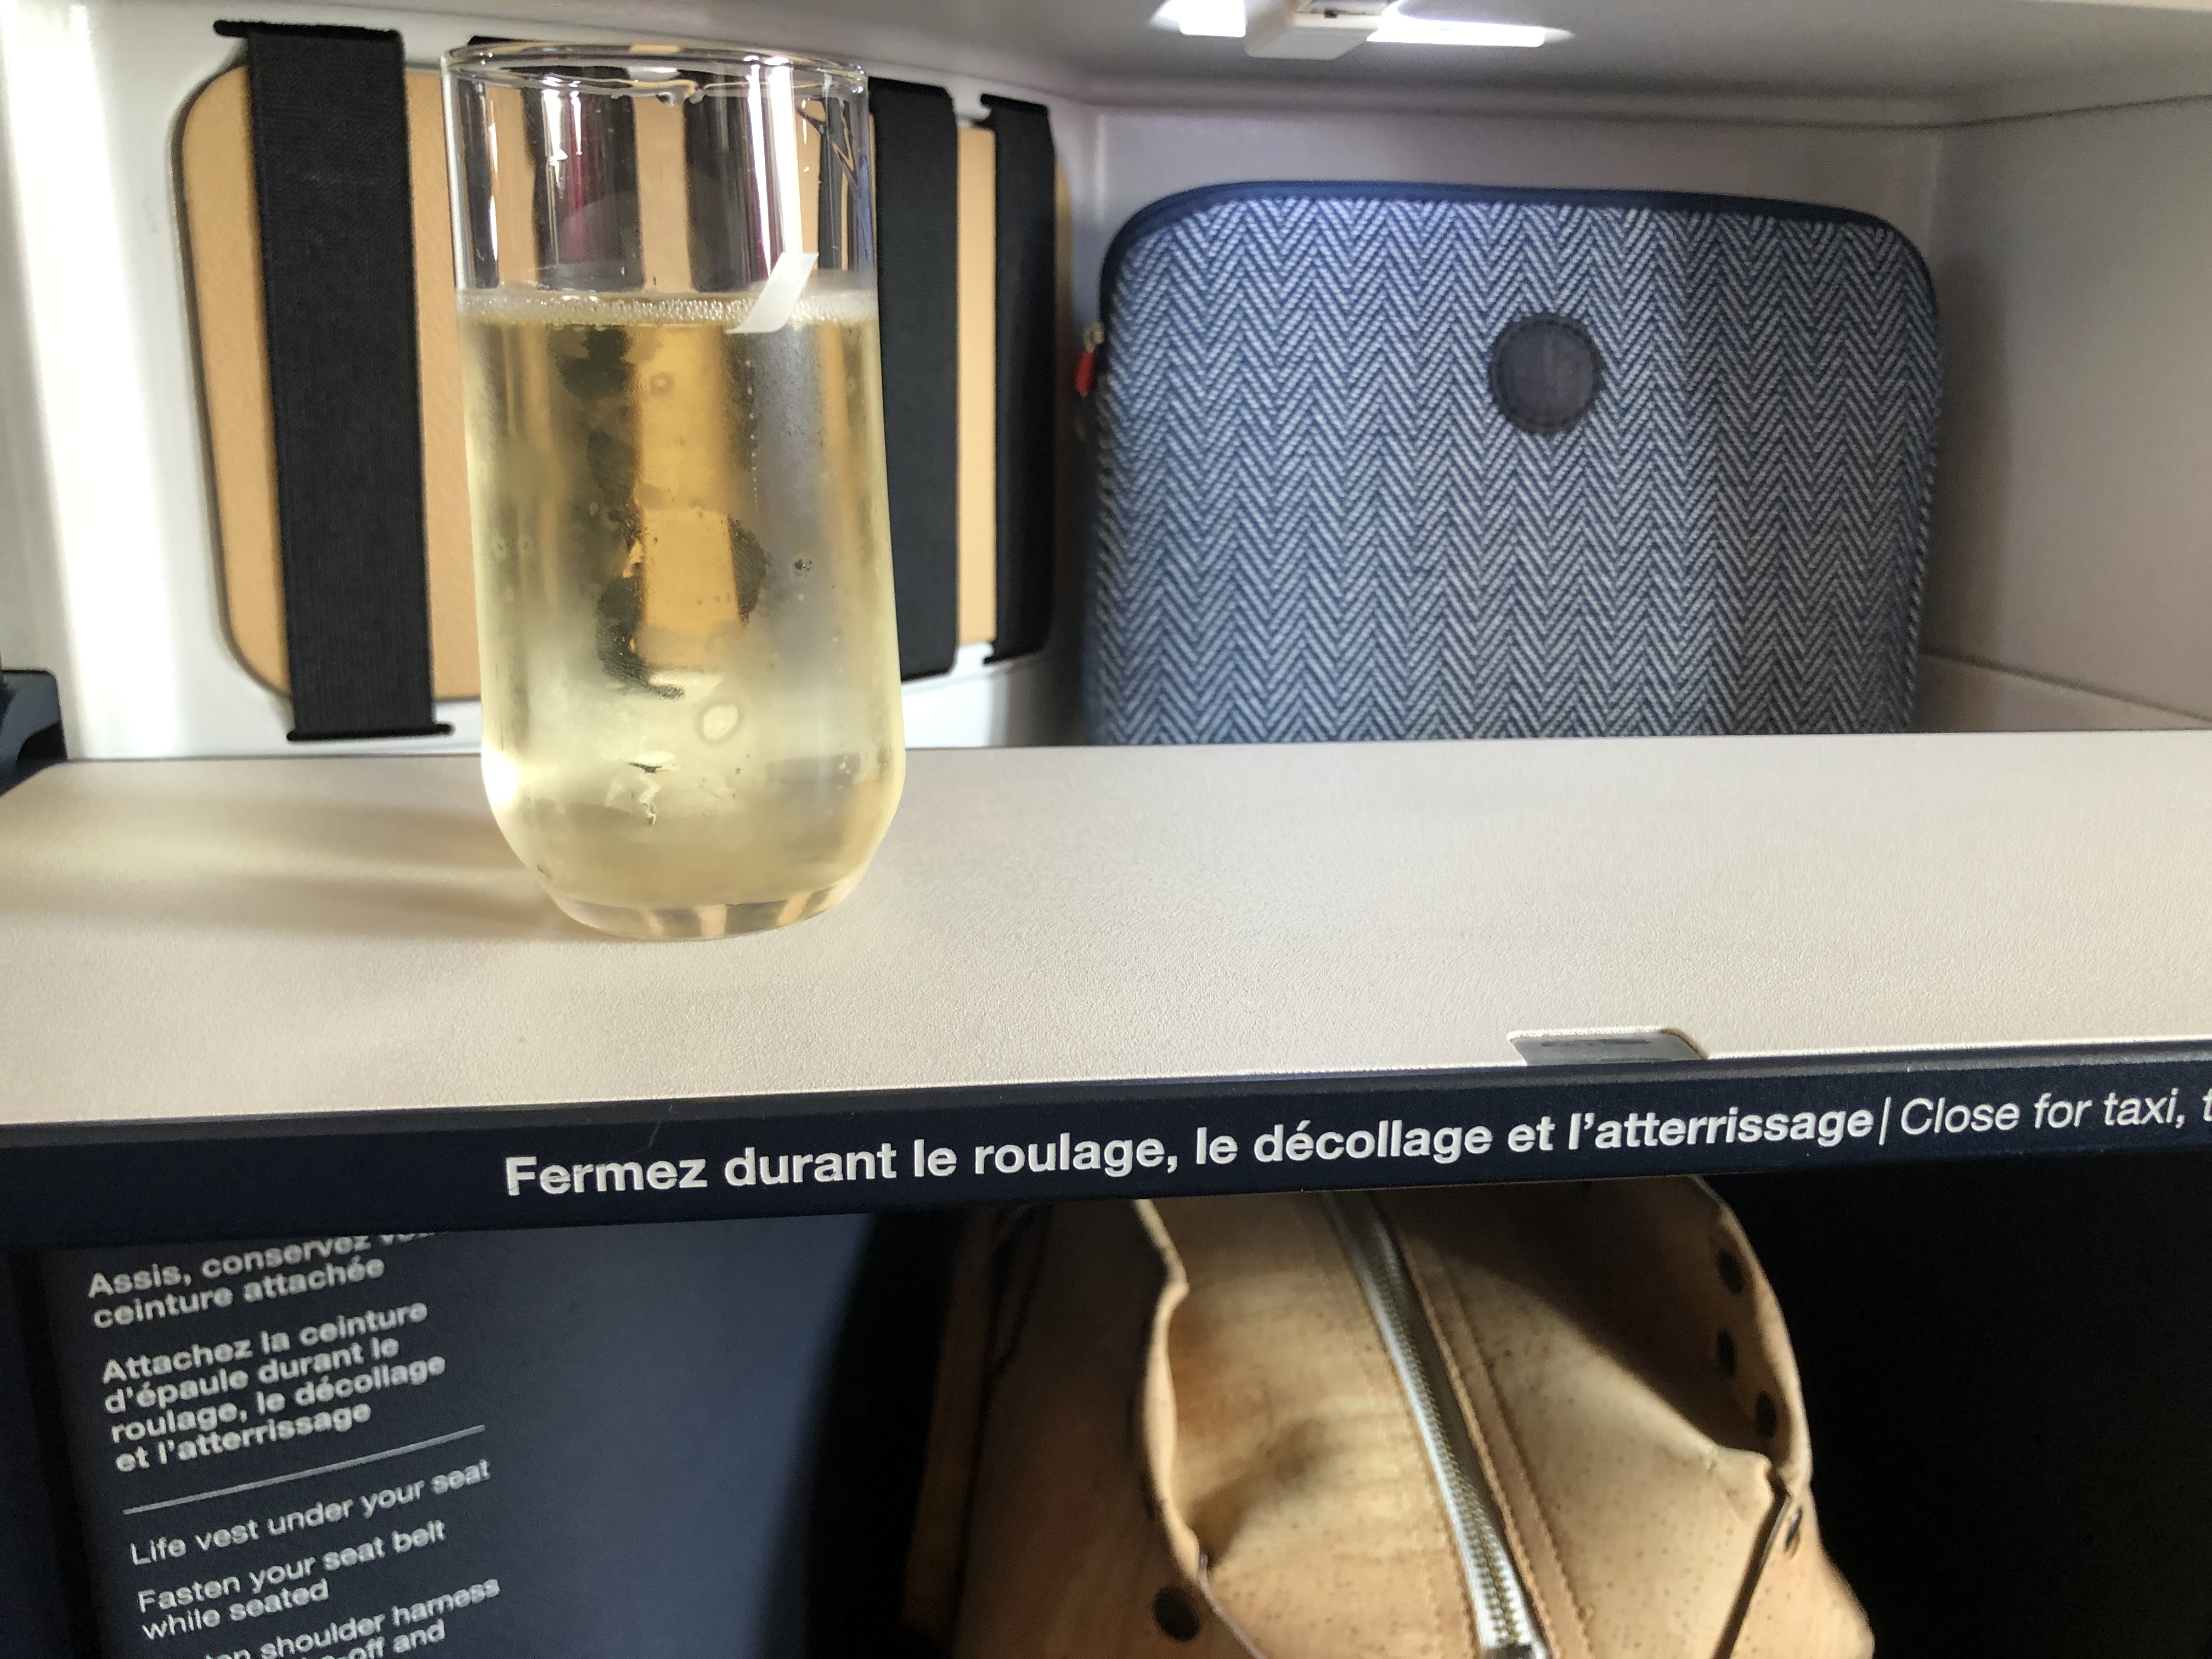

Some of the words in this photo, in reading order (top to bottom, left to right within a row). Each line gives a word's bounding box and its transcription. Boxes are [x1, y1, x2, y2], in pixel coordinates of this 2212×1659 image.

[1900, 1097, 2021, 1136] Close
[2033, 1092, 2093, 1129] for
[2103, 1088, 2185, 1128] taxi,
[506, 1156, 708, 1196] Fermez
[725, 1143, 897, 1187] durant
[914, 1139, 957, 1177] le
[975, 1133, 1178, 1177] roulage,
[1196, 1127, 1238, 1165] le
[1254, 1120, 1493, 1164] décollage
[1508, 1116, 1555, 1153] et
[89, 1263, 191, 1298] Assis,
[202, 1235, 371, 1279] conservez
[94, 1288, 233, 1328] ceinture
[244, 1255, 385, 1302] attachée
[103, 1339, 253, 1384] Attachez
[261, 1330, 290, 1354] la
[299, 1302, 427, 1346] ceinture
[258, 1342, 364, 1384] durant
[371, 1337, 399, 1359] le
[111, 1402, 247, 1443] roulage,
[256, 1391, 285, 1415] le
[294, 1356, 446, 1406] décollage
[115, 1446, 150, 1472] et
[131, 1537, 187, 1565] Life
[195, 1519, 259, 1551] vest
[267, 1499, 354, 1536] under
[360, 1480, 425, 1519] your
[430, 1459, 490, 1494] seat
[138, 1576, 241, 1613] Fasten
[249, 1556, 316, 1594] your
[322, 1536, 386, 1571] seat
[391, 1520, 445, 1553] belt
[142, 1608, 221, 1640] while
[229, 1578, 329, 1621] seated
[259, 1613, 386, 1659] shoulder
[393, 1618, 445, 1654] and
